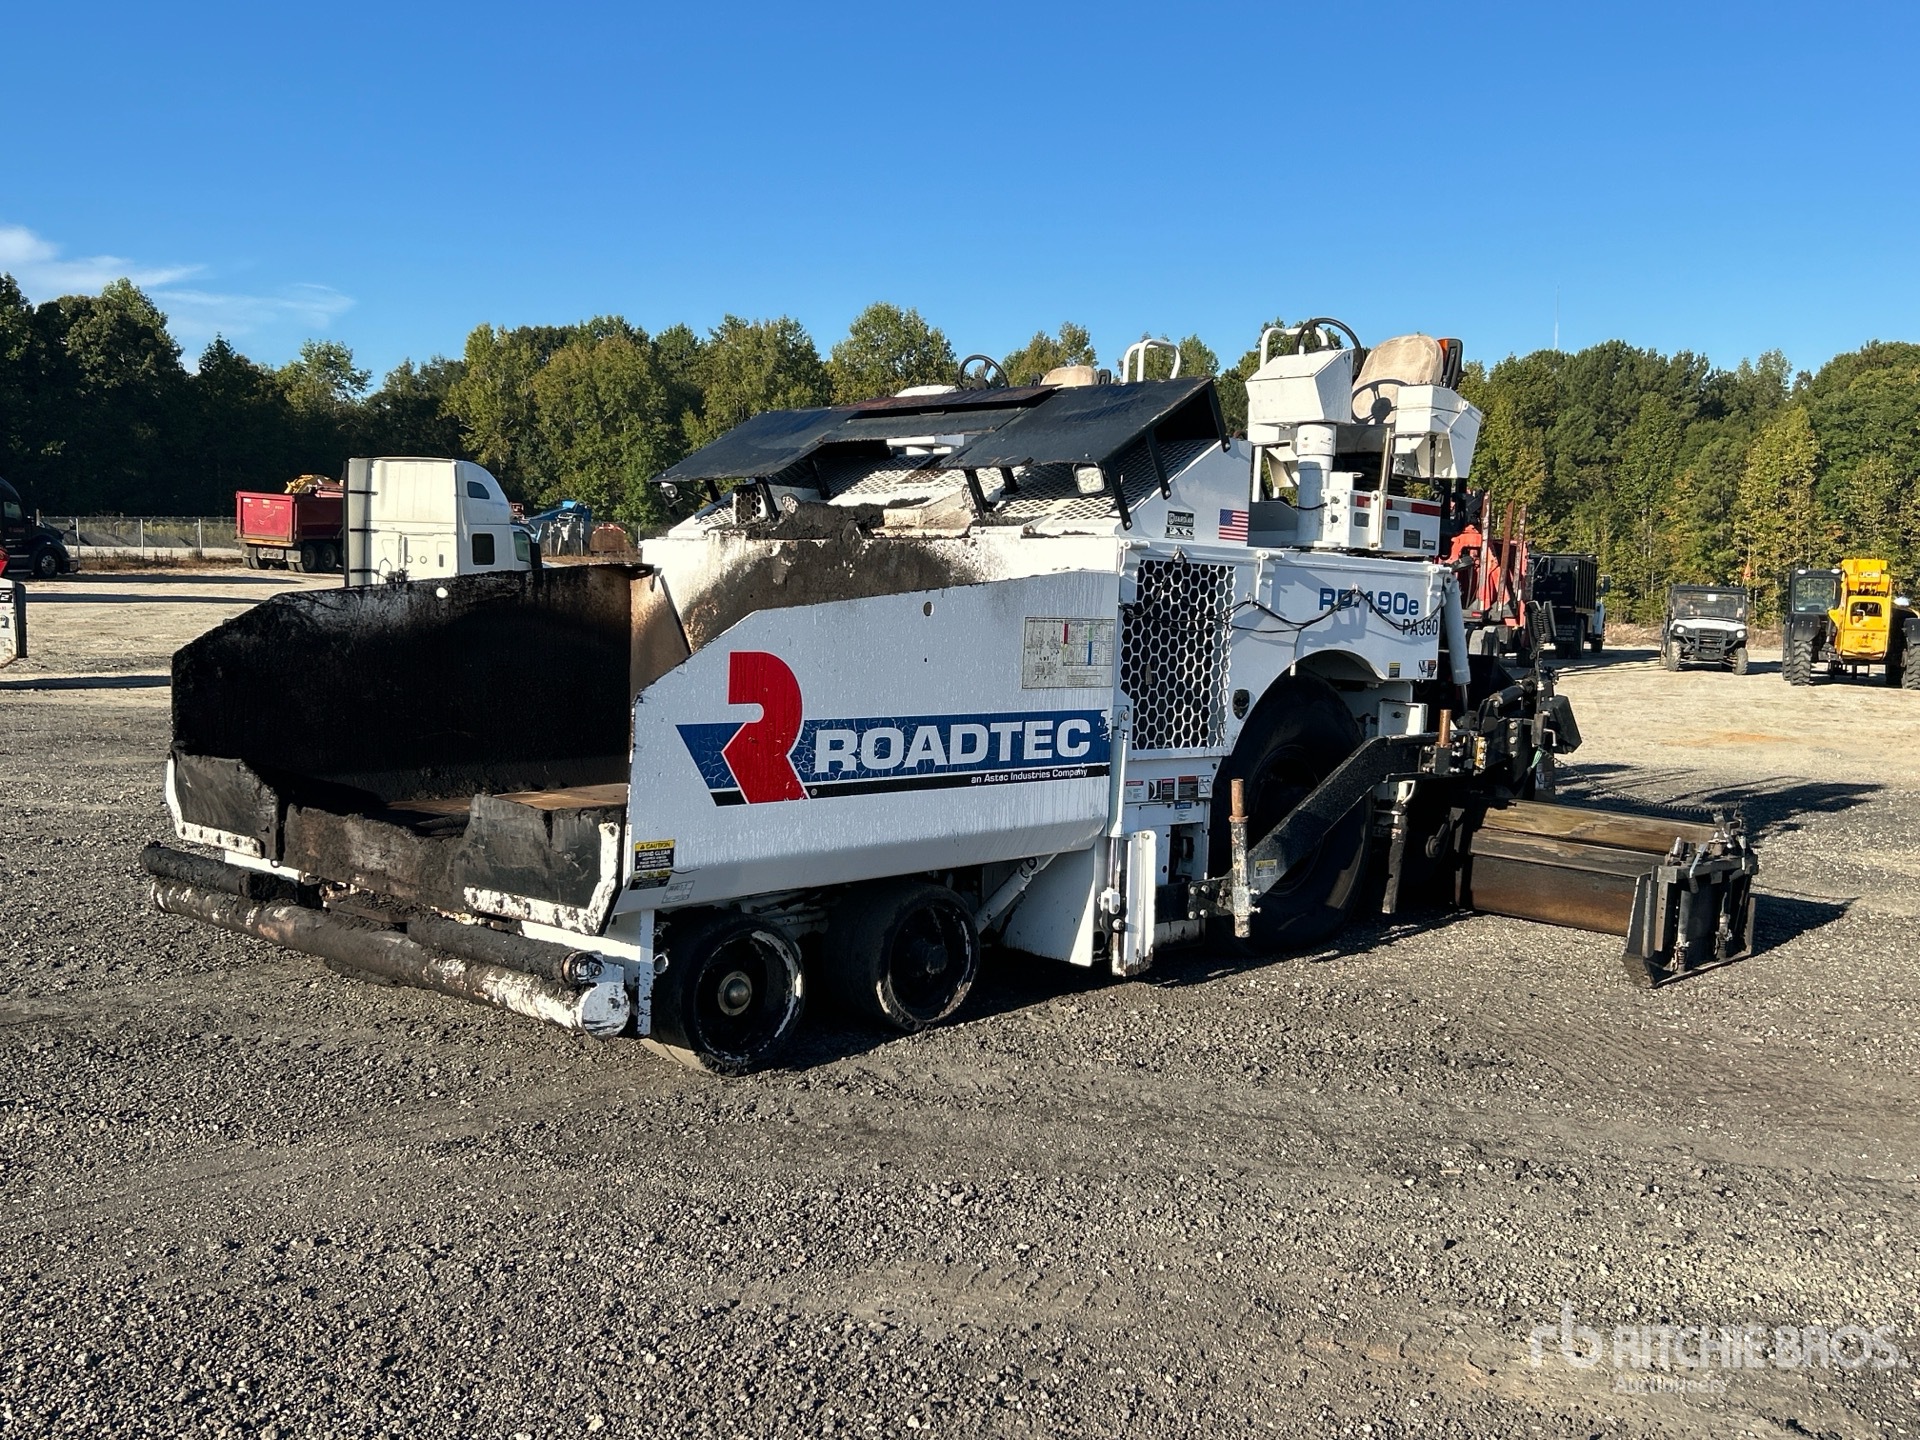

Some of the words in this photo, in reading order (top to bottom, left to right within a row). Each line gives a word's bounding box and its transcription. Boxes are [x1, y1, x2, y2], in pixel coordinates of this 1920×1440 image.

[1402, 618, 1438, 636] PA380
[813, 719, 1091, 774] ROADTEC
[970, 776, 982, 784] an
[984, 773, 1009, 782] Astec
[1010, 770, 1051, 781] Industries
[1052, 768, 1088, 778] Company
